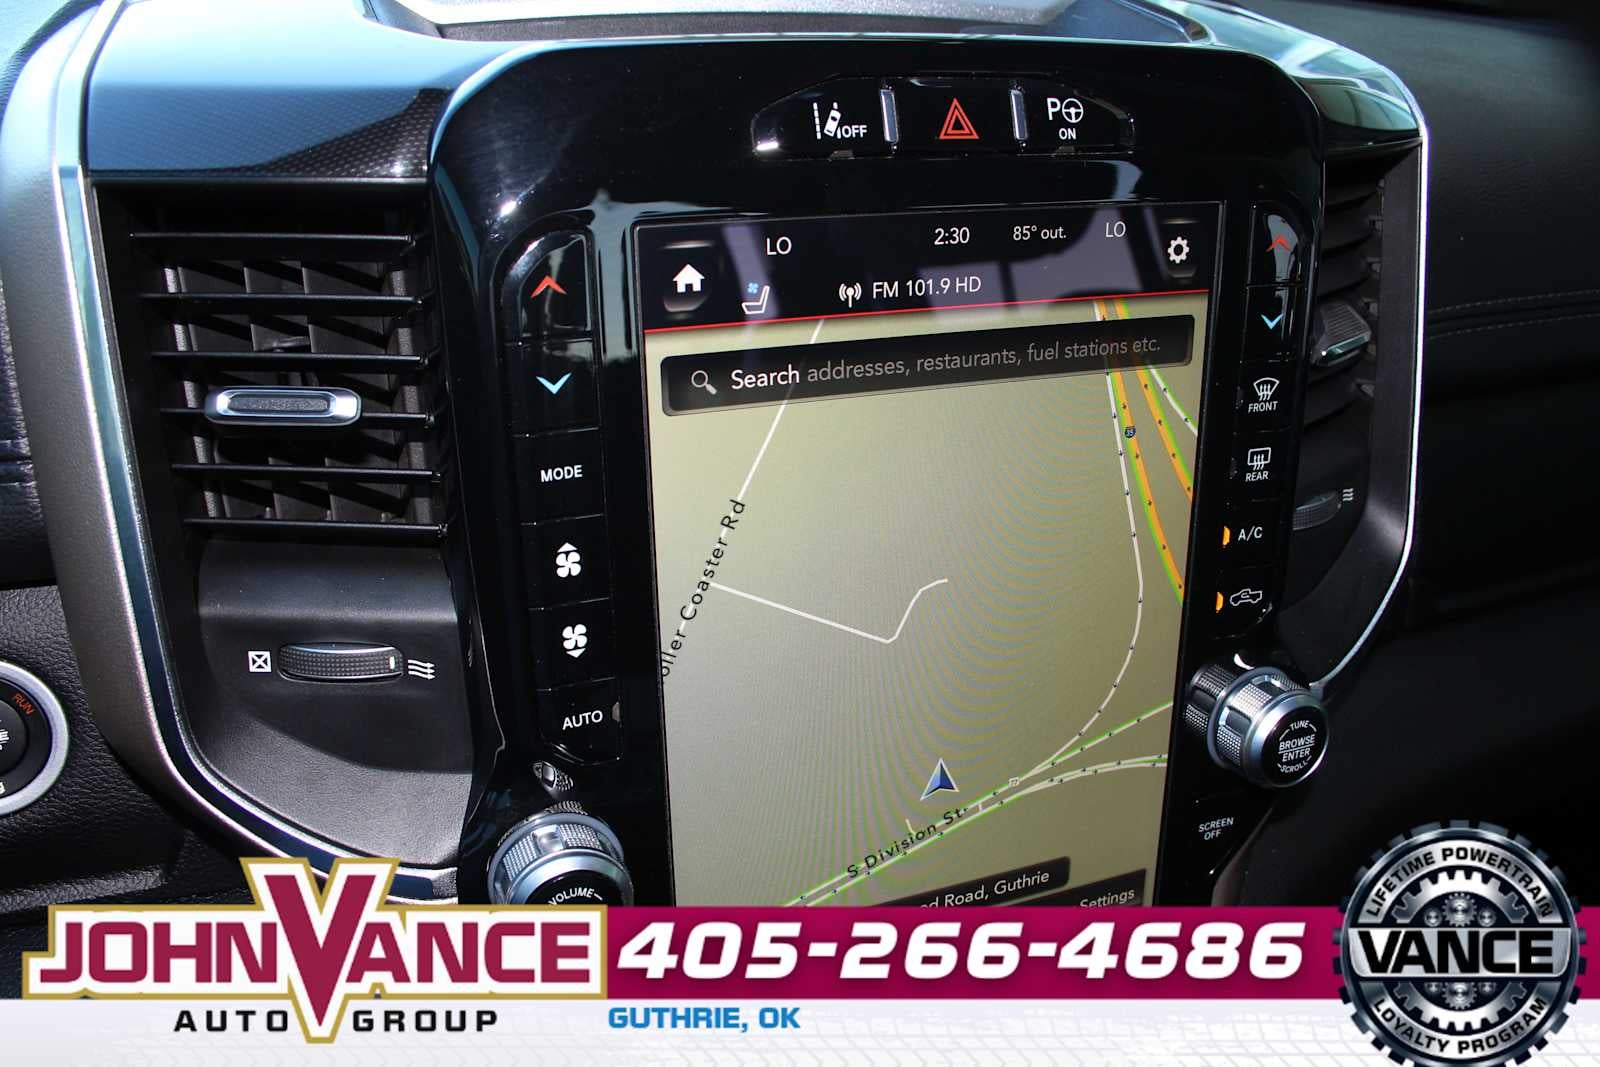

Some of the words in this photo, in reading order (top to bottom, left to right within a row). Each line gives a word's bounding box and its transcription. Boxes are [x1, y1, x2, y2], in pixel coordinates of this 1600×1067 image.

[842, 125, 868, 138] OFF
[1058, 128, 1077, 140] ON
[934, 226, 970, 245] 2:30
[1012, 225, 1038, 241] 85°
[1040, 225, 1067, 240] out.
[1104, 220, 1127, 239] LO
[765, 236, 793, 256] LO
[872, 281, 899, 299] FM
[906, 278, 951, 296] 101.9
[955, 276, 982, 294] HD
[729, 365, 801, 391] Search
[806, 356, 911, 383] addresses,
[916, 347, 1023, 373] restaurants,
[1027, 340, 1060, 362] fuel
[1063, 336, 1128, 360] stations
[1132, 335, 1161, 354] etc.
[1247, 400, 1278, 414] FRONT
[540, 464, 583, 483] MODE
[1245, 470, 1270, 483] REAR
[1237, 525, 1264, 542] A/C
[661, 629, 687, 678] oller
[680, 536, 729, 621] Coaster
[720, 498, 746, 530] Rd
[12, 692, 35, 716] RUN
[562, 709, 604, 730] AUTO
[1289, 720, 1310, 731] TUNE
[1279, 734, 1316, 751] BROWSE
[1281, 747, 1311, 762] ENTER
[1280, 760, 1309, 773] SCROLL
[1198, 815, 1235, 834] SCREEN
[1203, 827, 1222, 842] OFF
[847, 863, 859, 879] S
[864, 821, 938, 869] Division
[547, 887, 595, 906] VOLUME
[944, 884, 989, 908] Road,
[994, 869, 1050, 896] Guthrie
[1079, 888, 1136, 910] Settings
